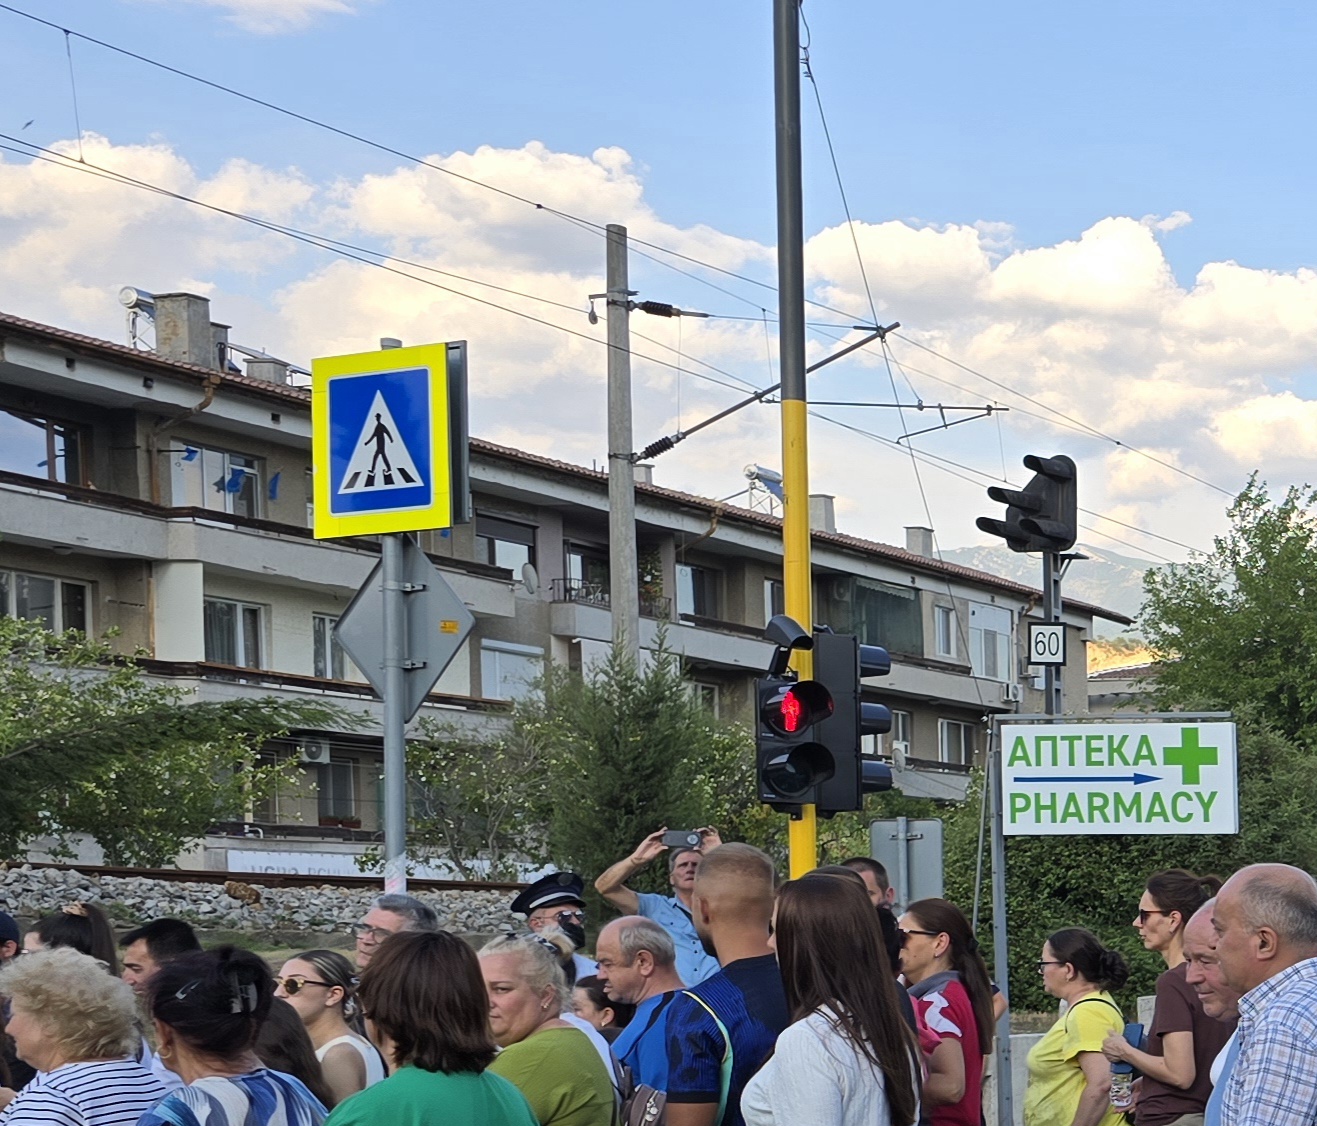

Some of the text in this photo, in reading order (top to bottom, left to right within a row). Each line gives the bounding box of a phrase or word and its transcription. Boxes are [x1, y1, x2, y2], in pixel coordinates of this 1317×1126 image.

[1034, 631, 1060, 657] 60
[1007, 735, 1158, 767] АПТЕКА
[1009, 791, 1218, 823] PHARMACY
